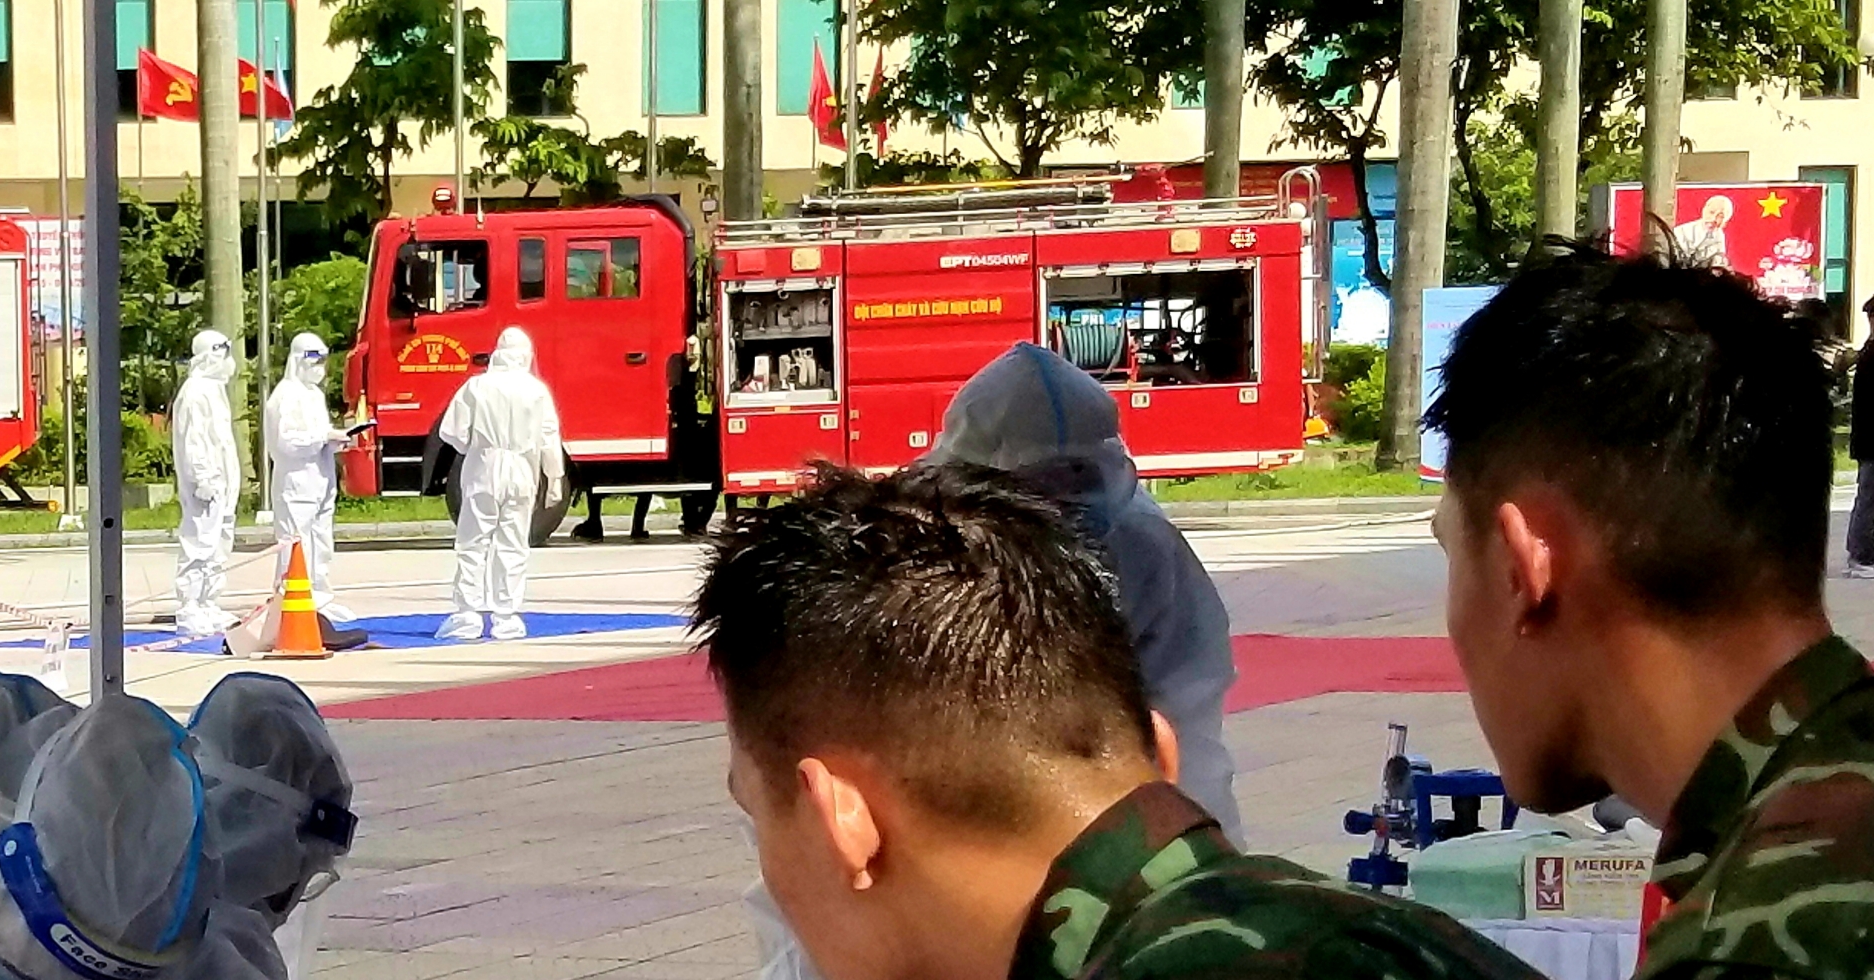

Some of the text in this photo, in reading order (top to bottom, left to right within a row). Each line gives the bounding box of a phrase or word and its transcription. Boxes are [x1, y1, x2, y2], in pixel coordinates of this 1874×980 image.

[1574, 860, 1646, 872] MERUFA
[60, 934, 142, 979] Face Sh
